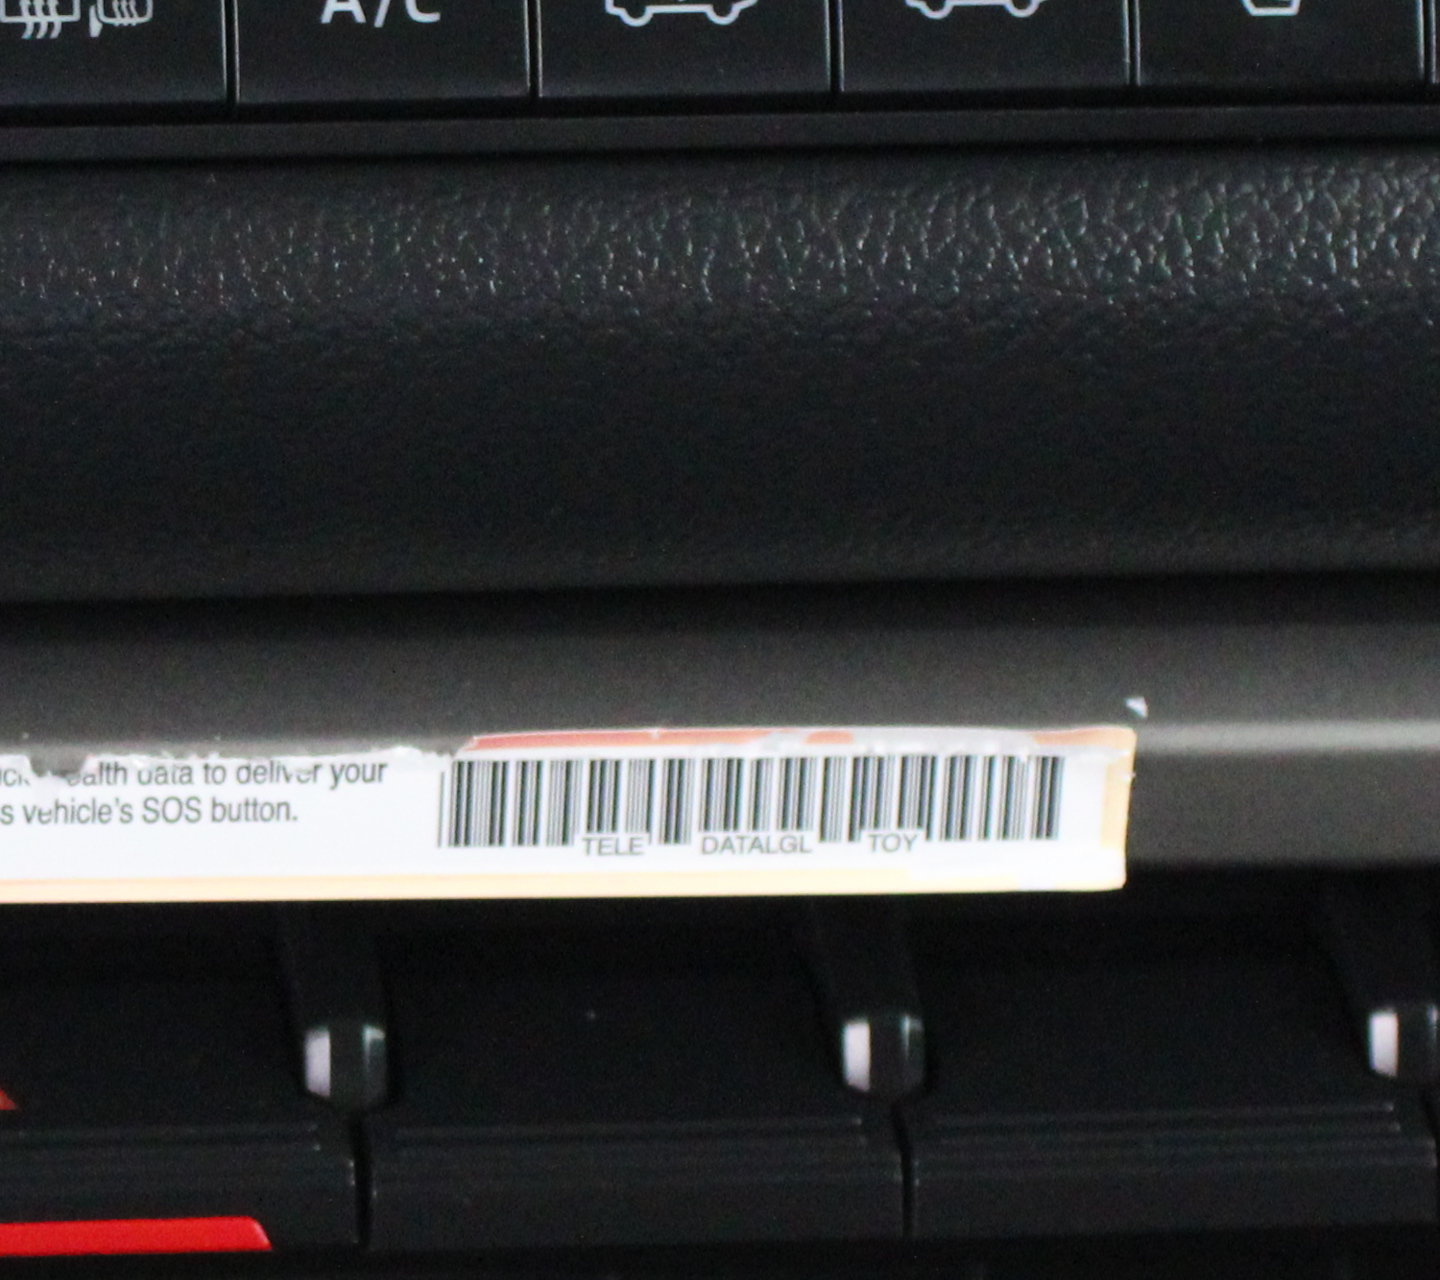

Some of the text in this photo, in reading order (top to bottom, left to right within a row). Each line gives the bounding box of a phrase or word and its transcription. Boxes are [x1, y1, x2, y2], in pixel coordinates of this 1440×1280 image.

[202, 761, 227, 783] to
[235, 760, 322, 782] deliver
[331, 761, 388, 790] your
[22, 798, 133, 824] vehicle's
[142, 796, 201, 824] SOS
[211, 797, 297, 823] button.
[584, 833, 917, 855] TELE DATALGL TOY
